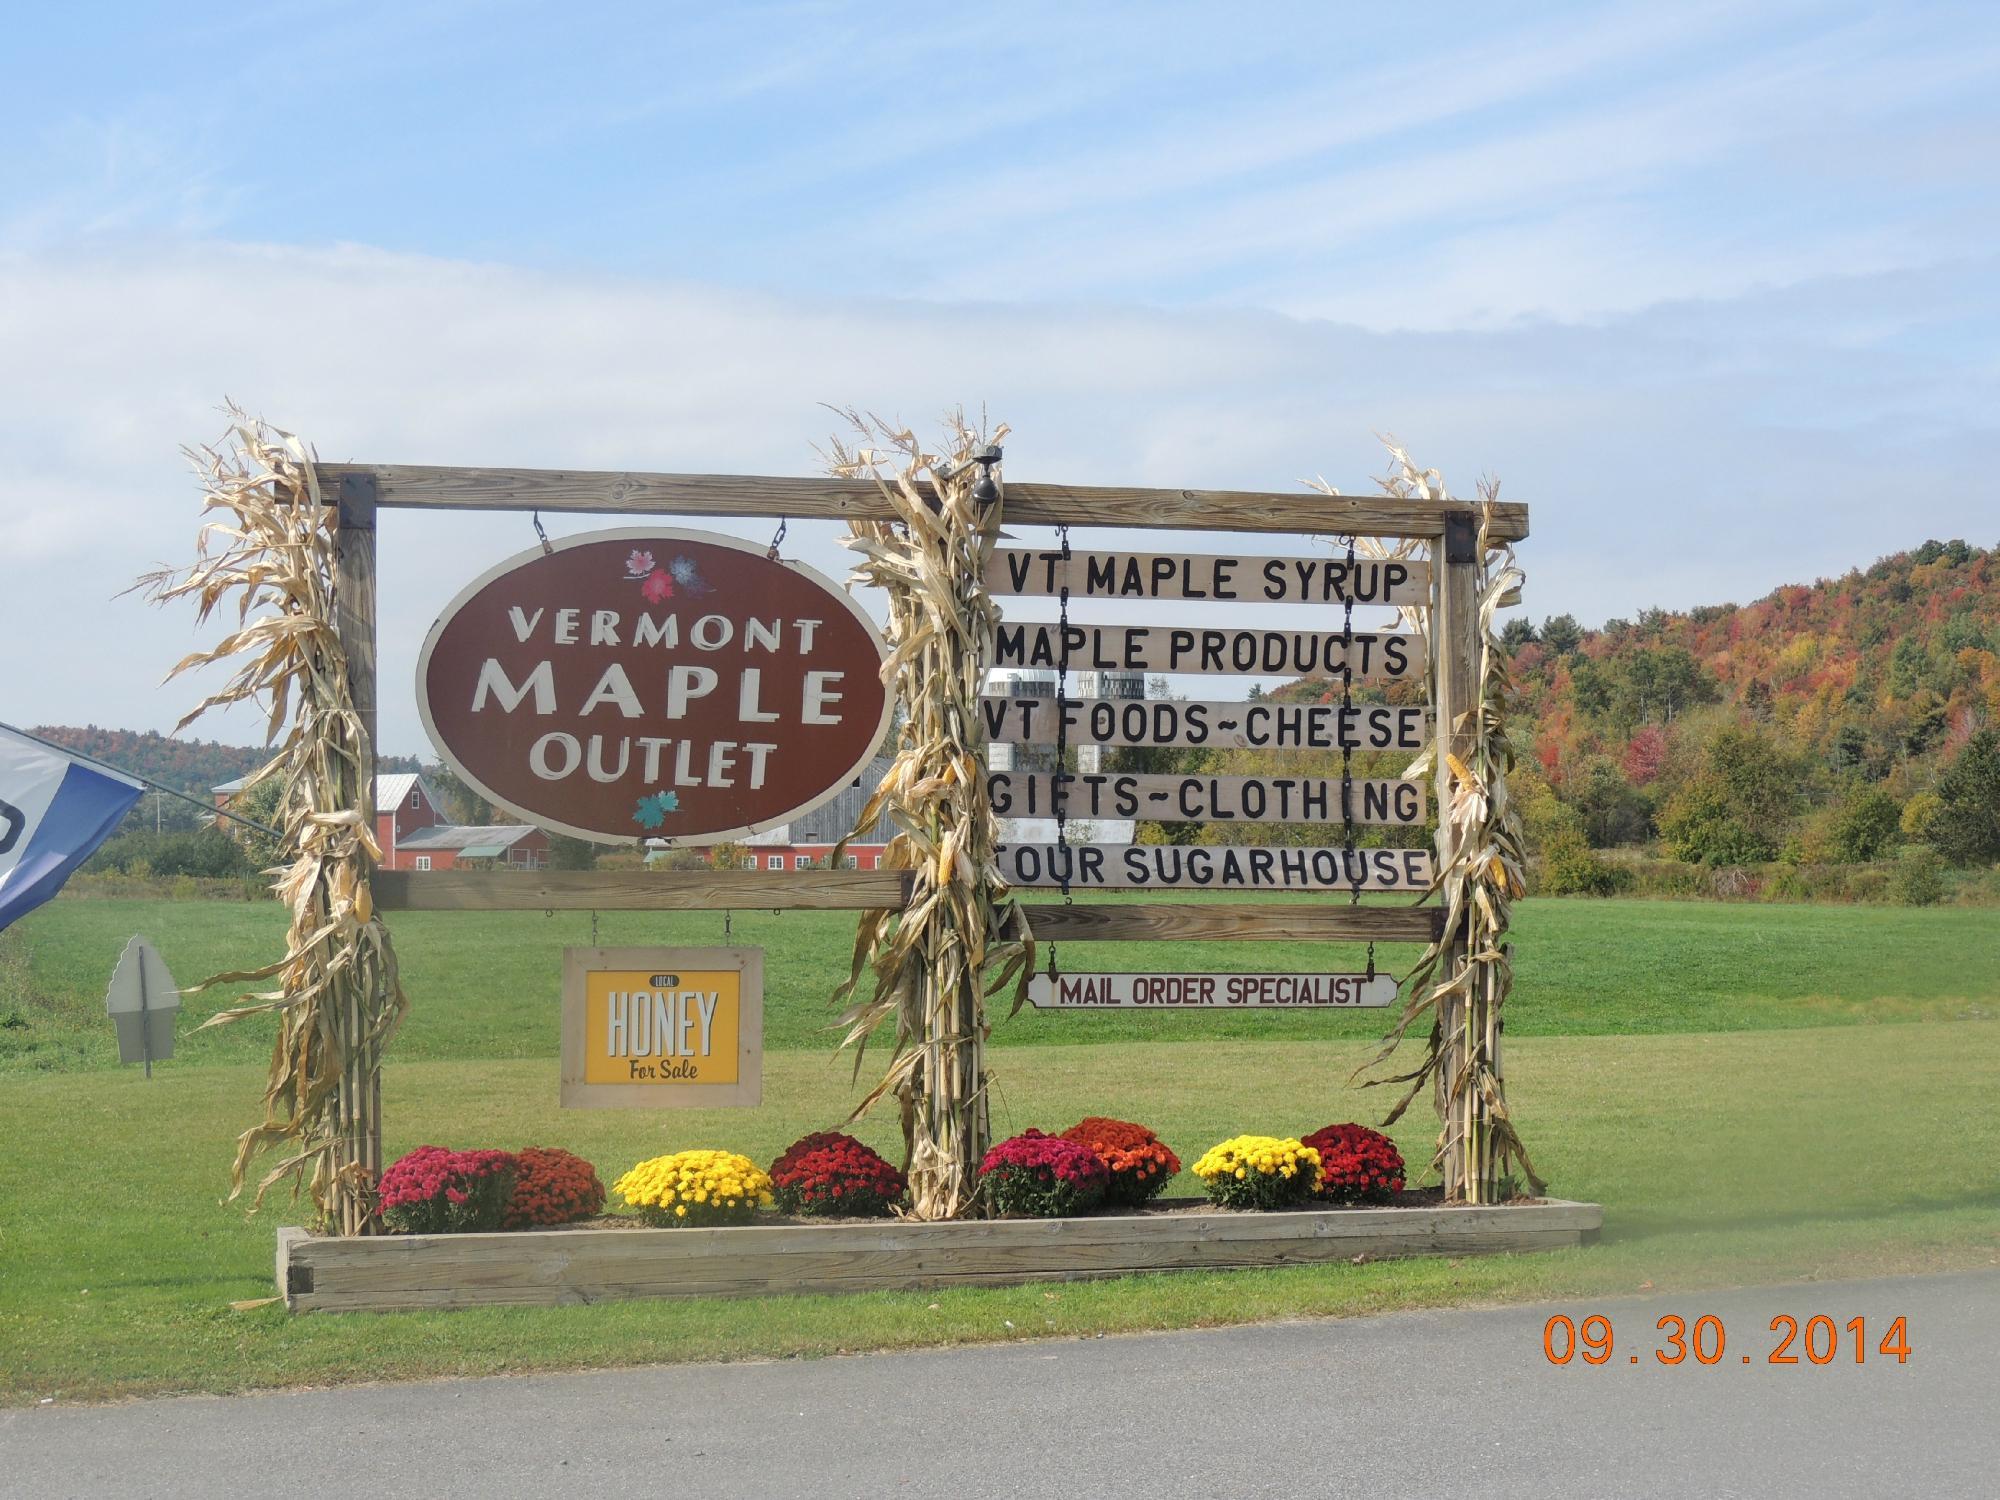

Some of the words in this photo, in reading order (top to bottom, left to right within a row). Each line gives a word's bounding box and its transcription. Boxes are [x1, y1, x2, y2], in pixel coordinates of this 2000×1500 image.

[1007, 552, 1067, 593] VT
[1087, 556, 1238, 599] MAPLE
[1263, 560, 1408, 602] SYRUP
[508, 606, 823, 655] VERMONT
[996, 625, 1150, 669] MAPLE
[1170, 630, 1408, 675] PRODUCTS
[471, 658, 844, 725] MAPLE
[984, 700, 1039, 739] VT
[529, 731, 778, 790] OUTLET
[1126, 847, 1430, 886] SUGARHOUSE
[655, 975, 674, 987] LOCAL
[1060, 977, 1121, 1004] MAIL
[1133, 977, 1215, 1004] ORDER
[1227, 977, 1367, 1004] SPECIALIST
[607, 991, 719, 1057] HONEY
[629, 1059, 656, 1079] For
[660, 1059, 698, 1079] Sale
